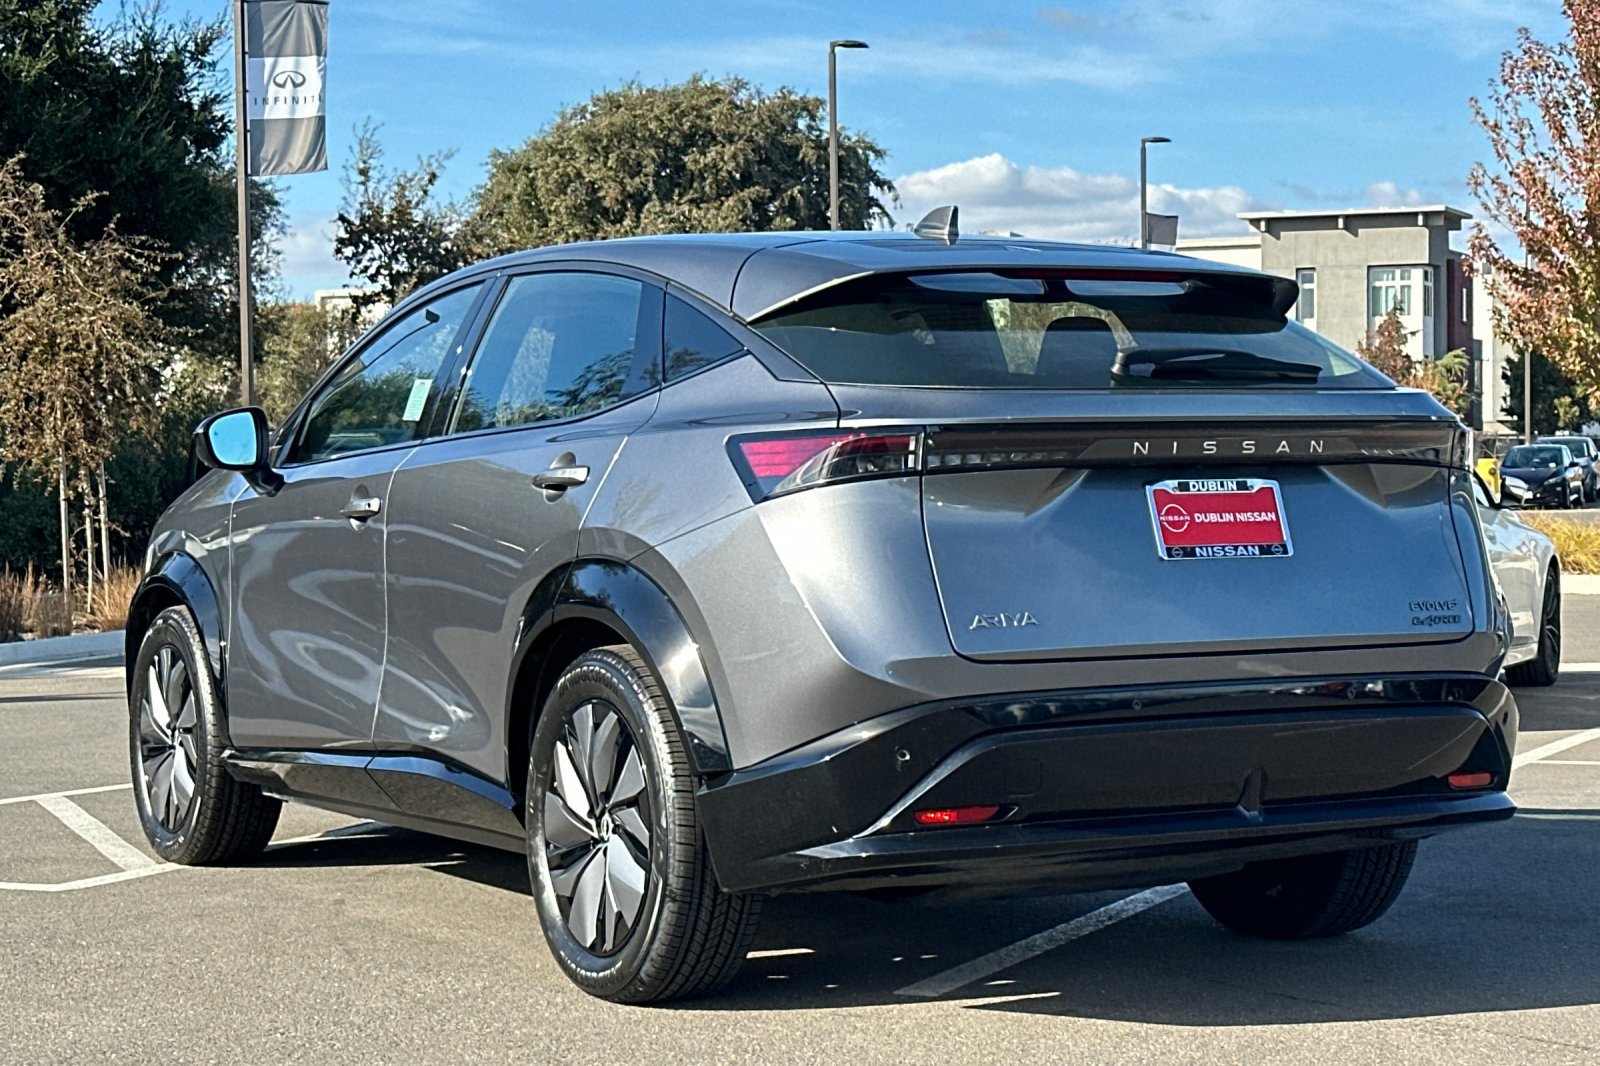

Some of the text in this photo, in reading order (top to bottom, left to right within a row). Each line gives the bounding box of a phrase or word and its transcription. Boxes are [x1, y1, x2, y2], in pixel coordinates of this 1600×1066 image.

[1132, 439, 1324, 455] NISSAN
[1189, 480, 1238, 492] DUBLIN
[1194, 511, 1277, 523] DUBLIN NISSAN
[1194, 545, 1261, 557] NISSAN
[968, 611, 1040, 630] ARIYA
